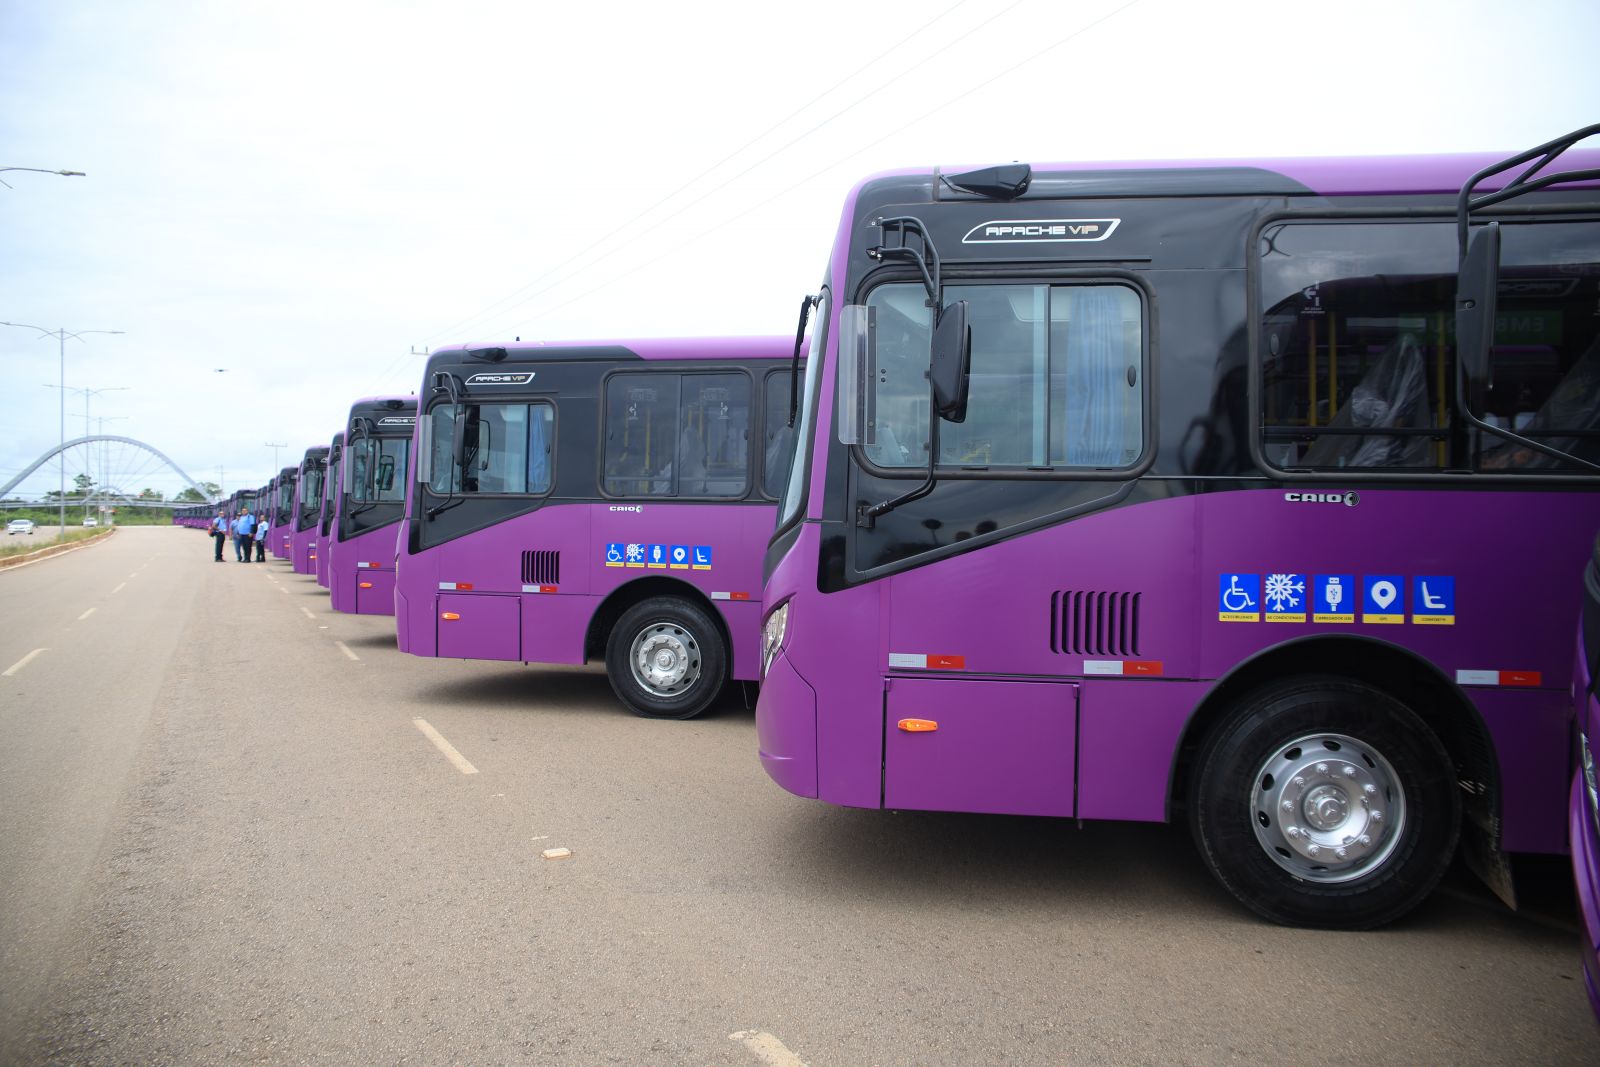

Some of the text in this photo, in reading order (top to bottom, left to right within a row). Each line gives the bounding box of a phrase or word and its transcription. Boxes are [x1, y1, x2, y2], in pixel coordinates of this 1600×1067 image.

[985, 225, 1099, 236] APACHE VIP
[1284, 492, 1342, 503] CAIO
